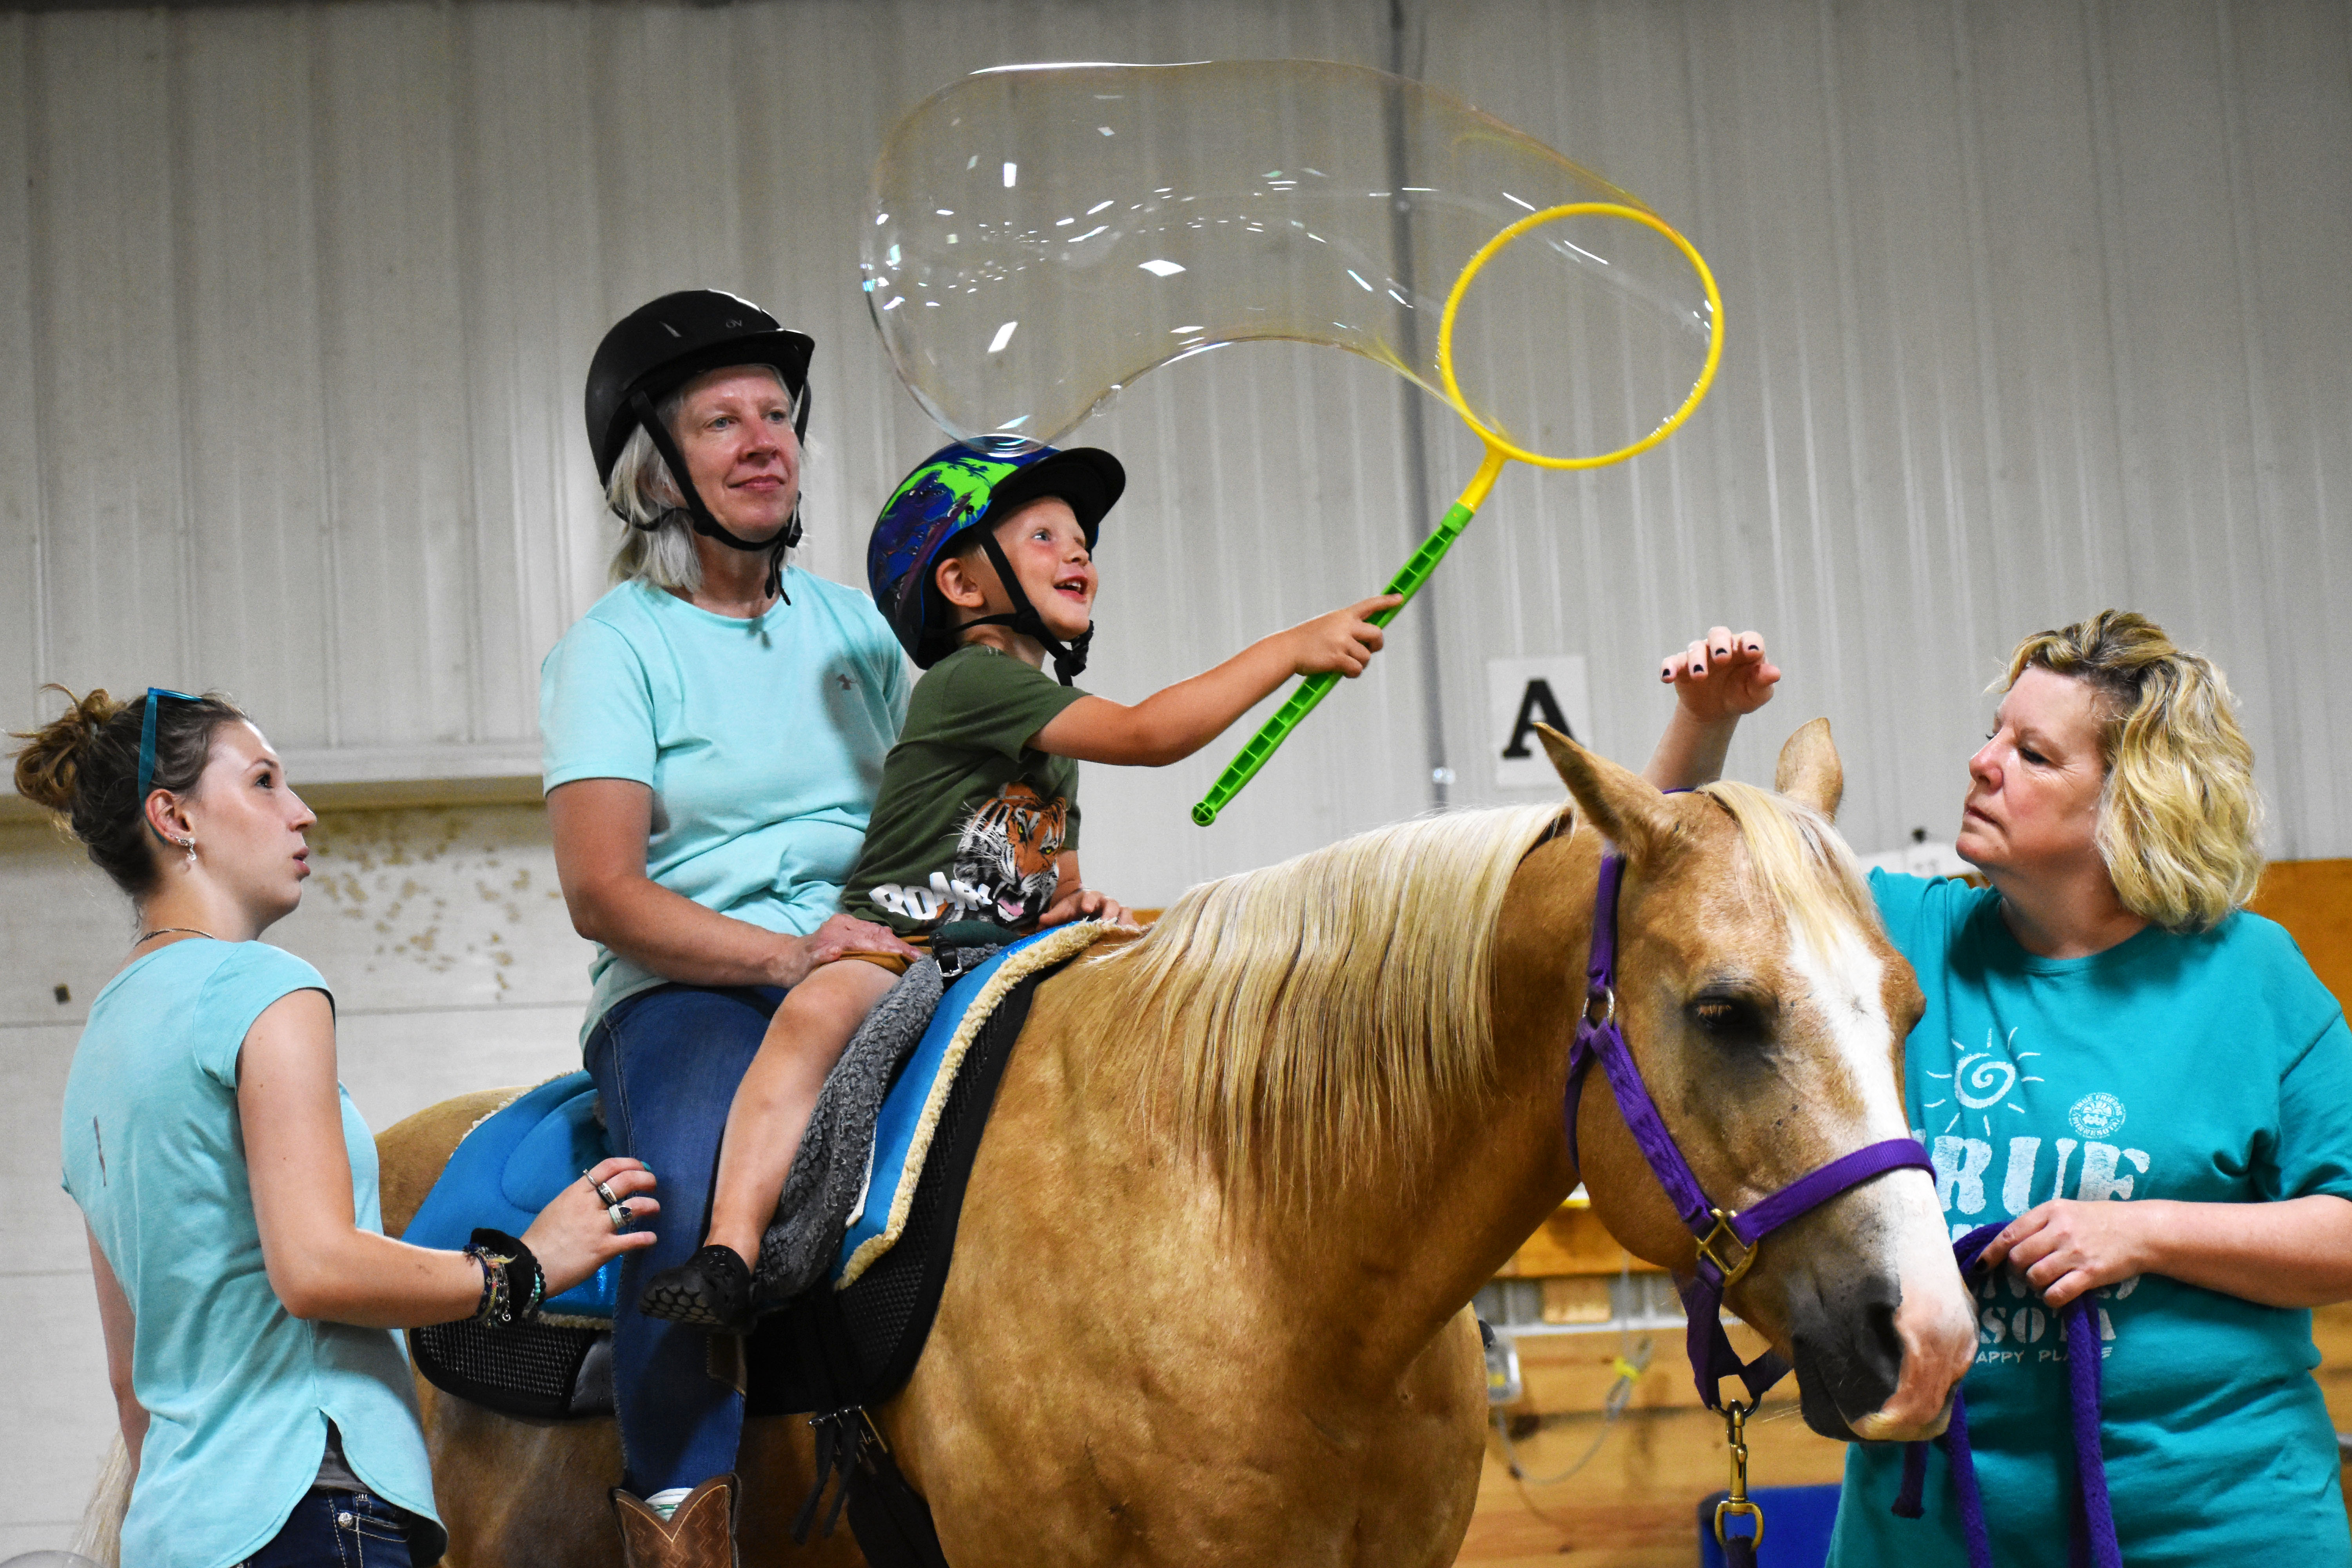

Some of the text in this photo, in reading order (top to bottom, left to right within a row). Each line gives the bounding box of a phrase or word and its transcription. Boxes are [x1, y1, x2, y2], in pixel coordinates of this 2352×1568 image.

[1503, 679, 1586, 758] A
[1911, 1129, 2150, 1216] RUE
[1976, 1350, 2024, 1364] APPY
